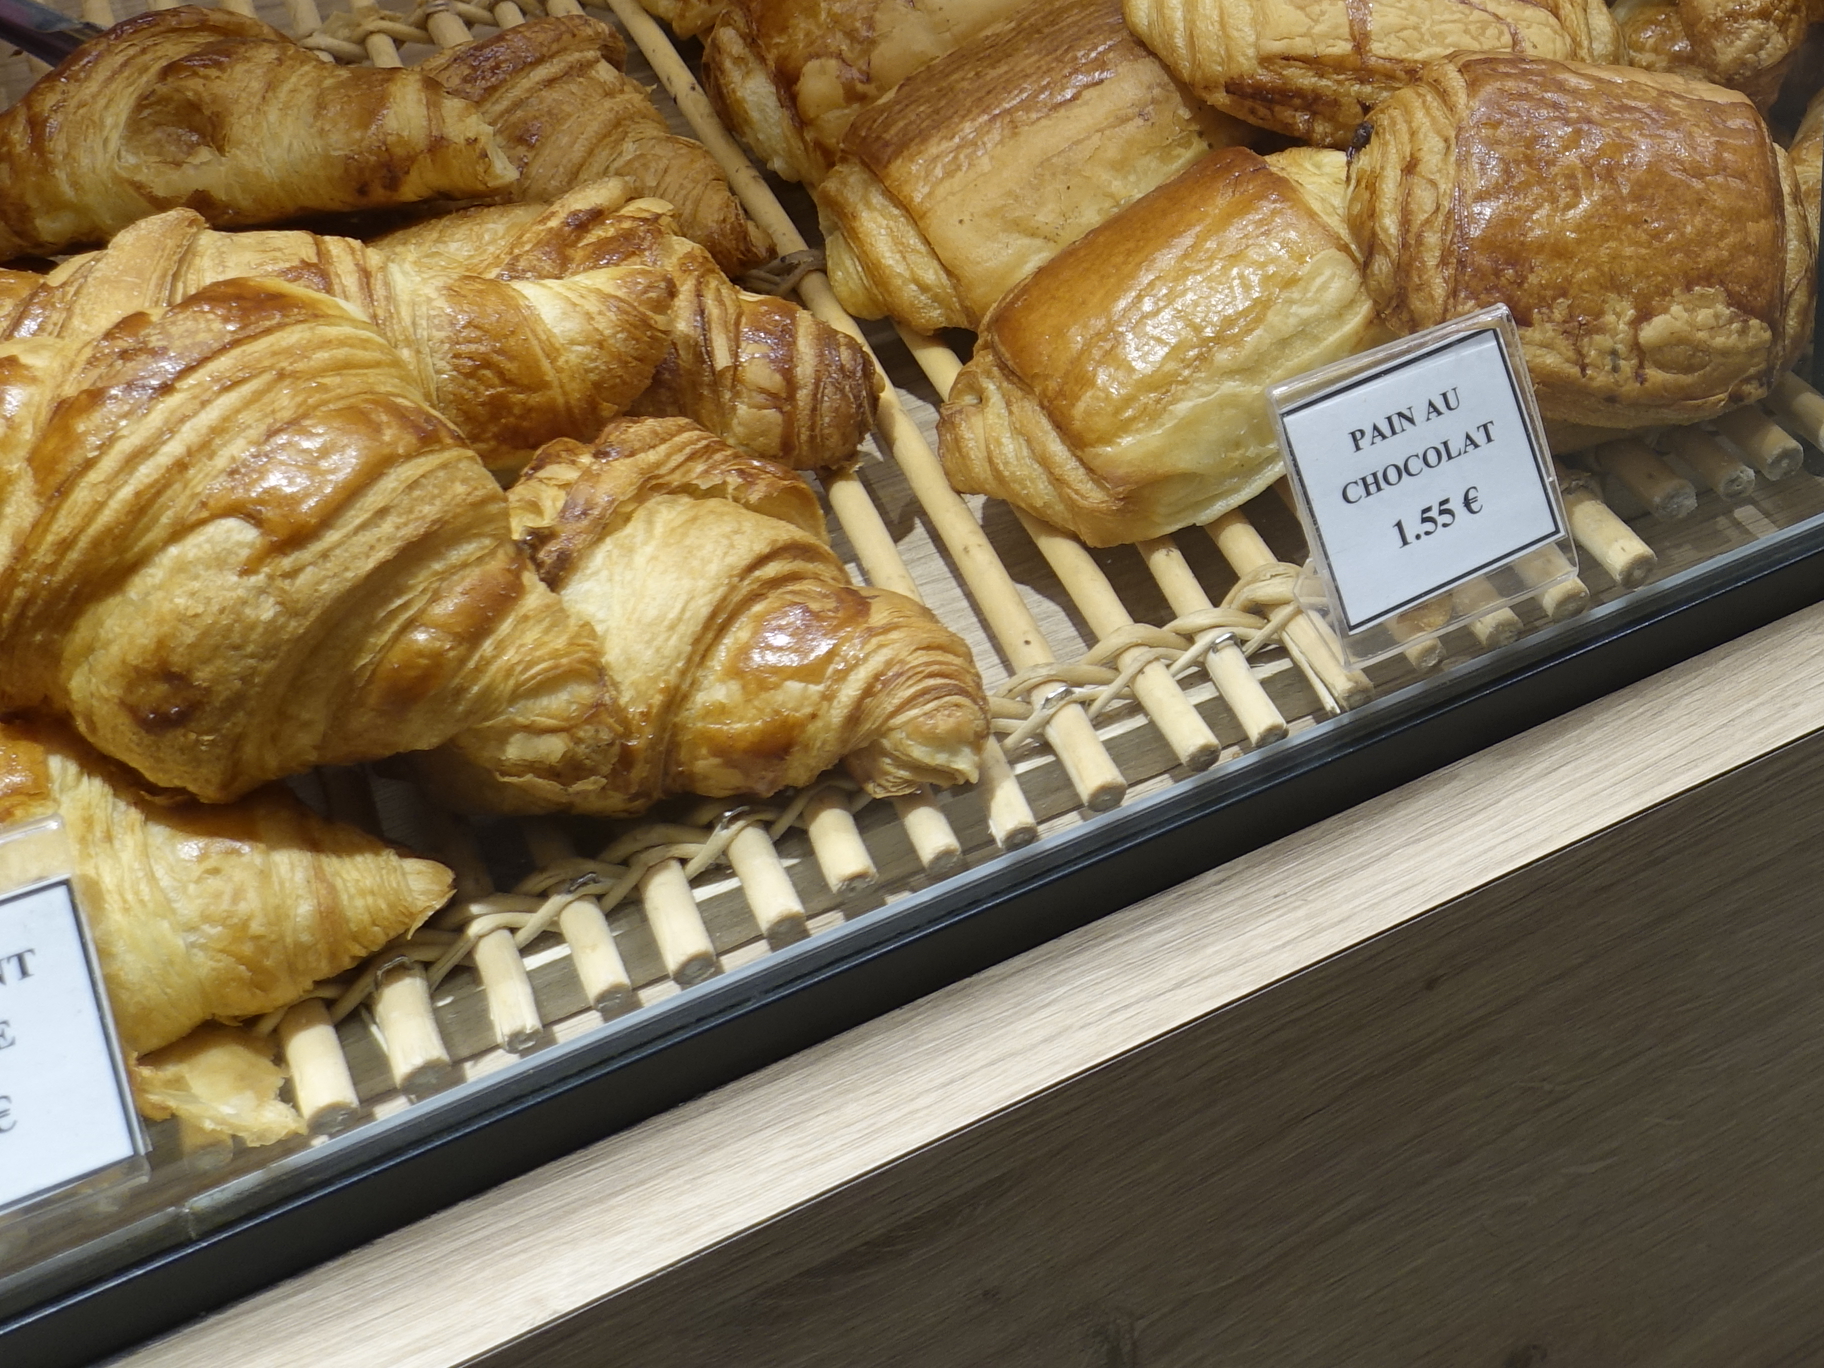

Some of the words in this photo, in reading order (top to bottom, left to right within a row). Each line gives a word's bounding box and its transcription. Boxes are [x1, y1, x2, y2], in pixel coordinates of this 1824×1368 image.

[1348, 406, 1418, 453] PAIN
[1425, 387, 1461, 422] AU
[1341, 420, 1495, 505] CHOCOLAT
[1393, 497, 1456, 548] 1.55
[1462, 486, 1483, 514] €
